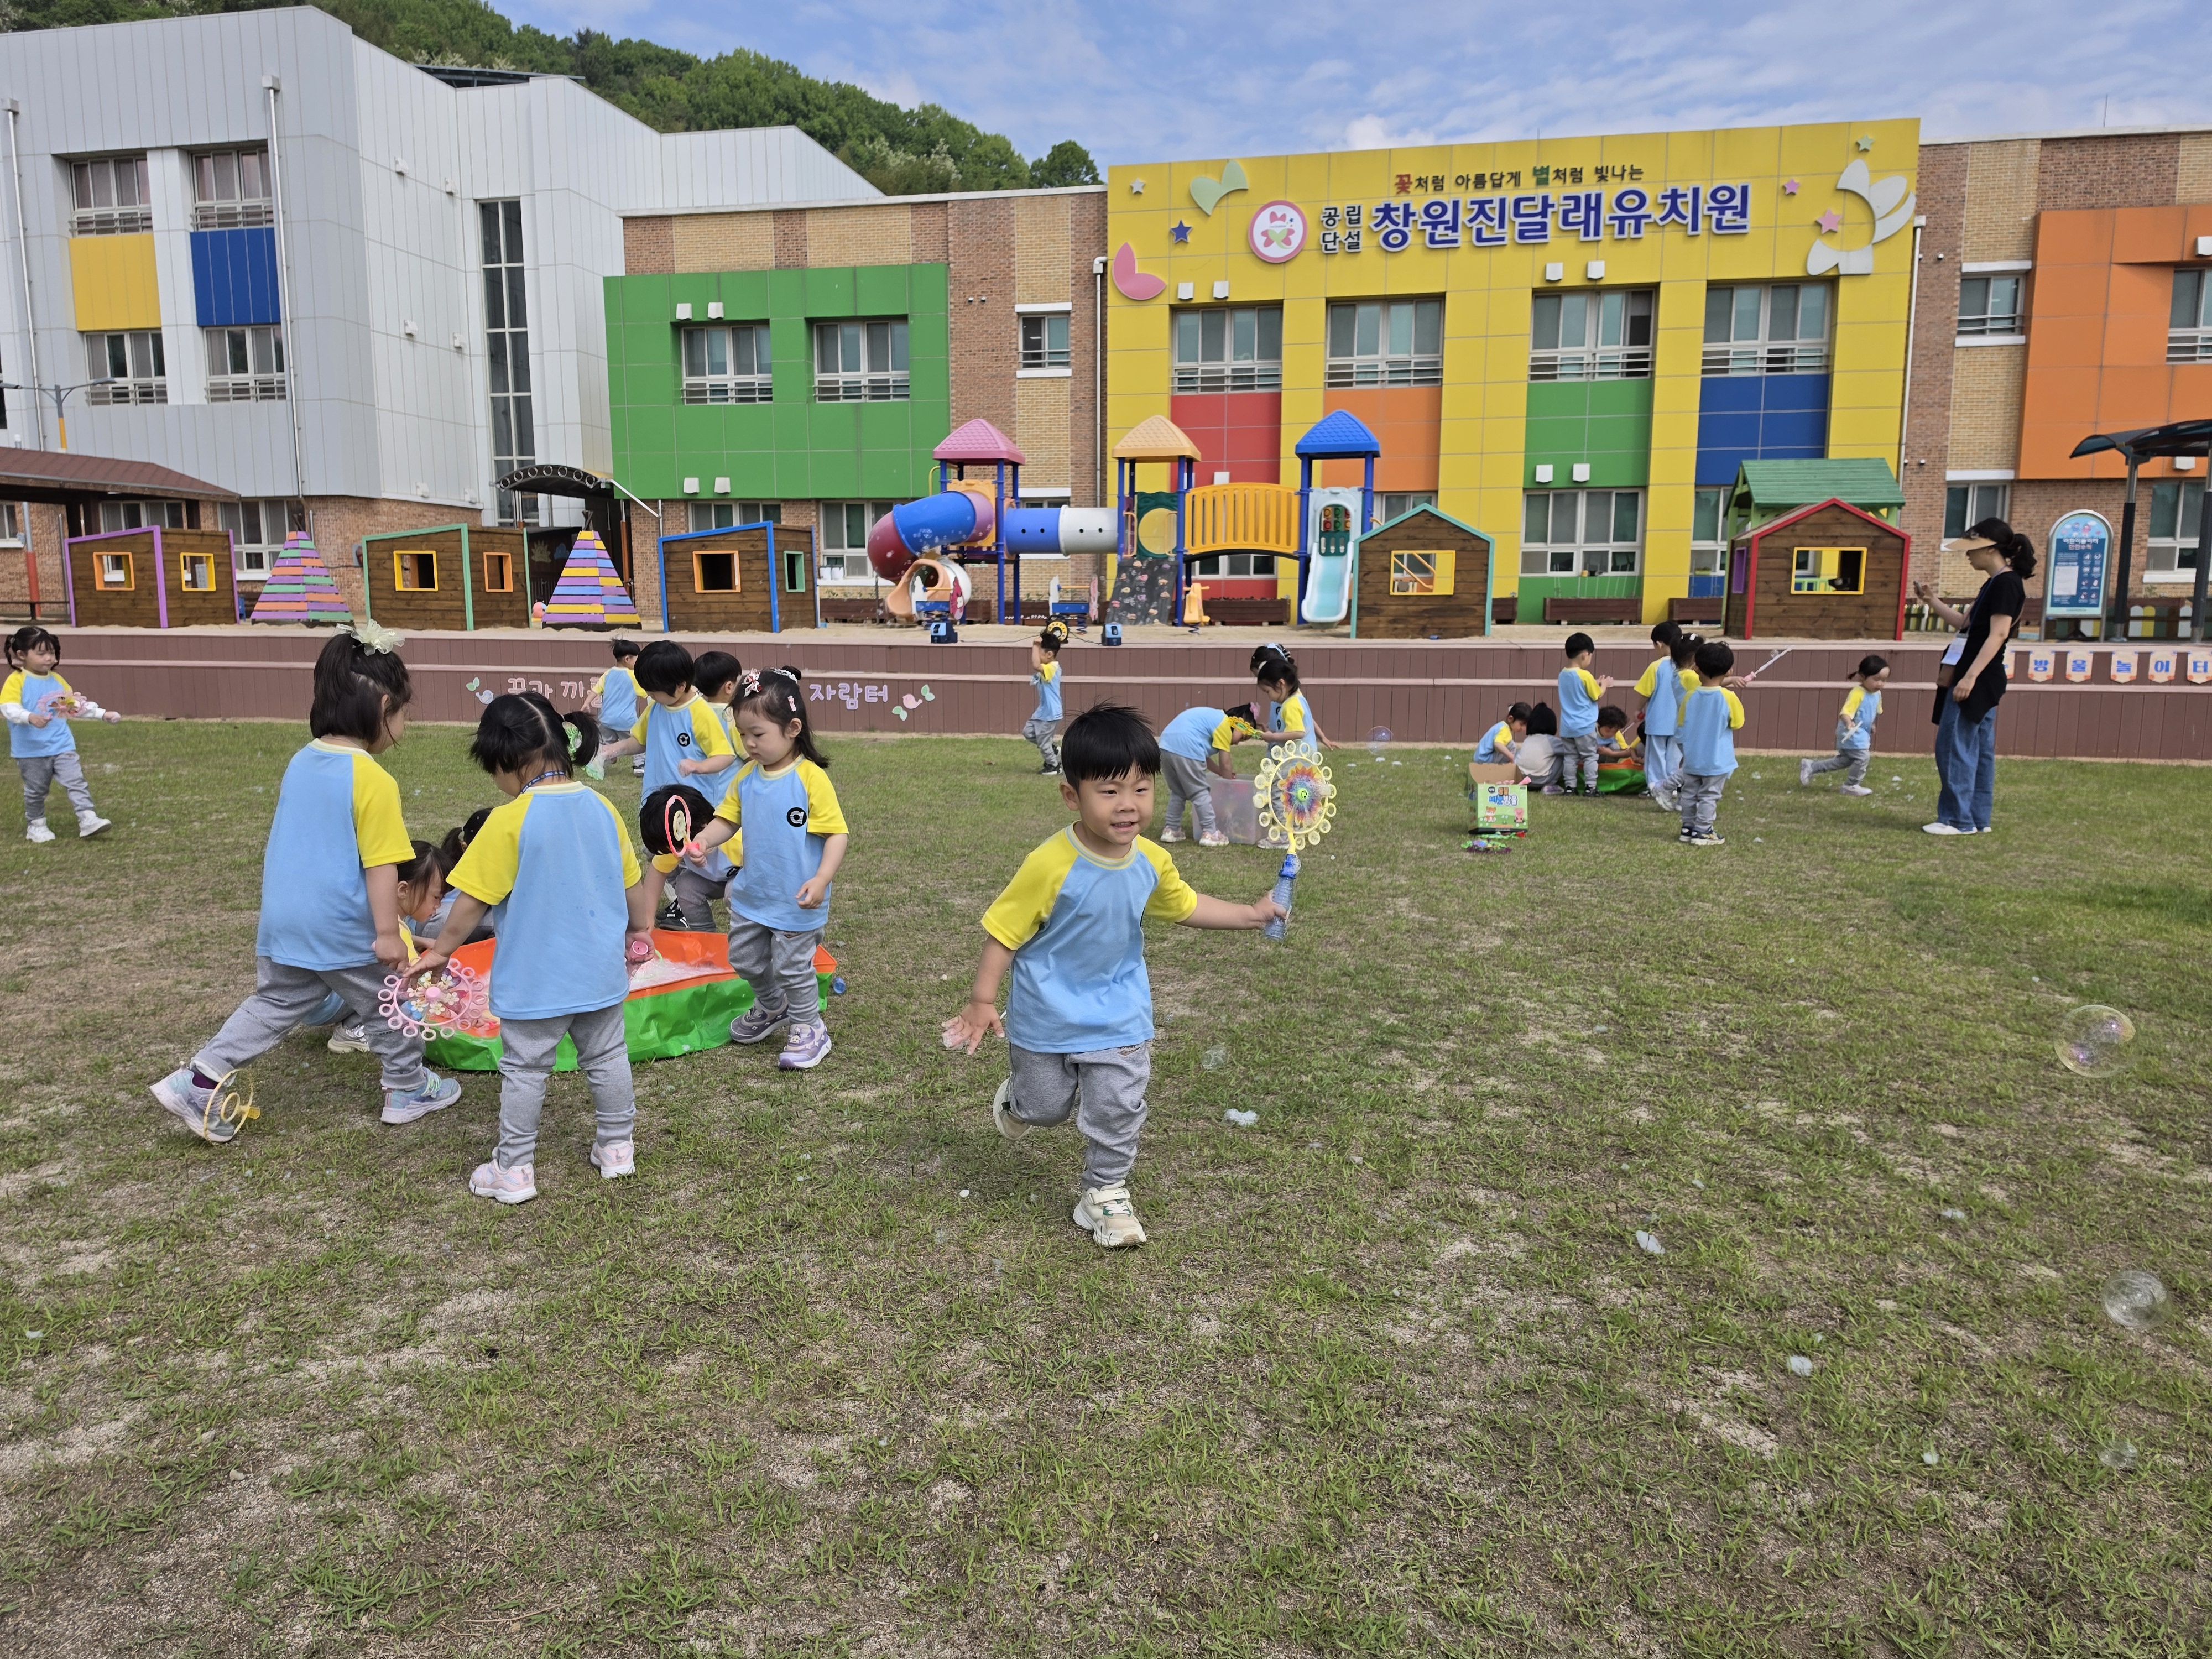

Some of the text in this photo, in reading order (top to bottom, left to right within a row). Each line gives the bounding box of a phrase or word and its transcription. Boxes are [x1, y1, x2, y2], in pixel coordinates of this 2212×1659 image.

[1394, 164, 1645, 194] 꽃처럼 아름답게 별처럼 빛나는
[1321, 205, 1361, 228] 공립
[1371, 184, 1751, 250] 창원진달래유치원
[1321, 231, 1361, 252] 단설
[808, 682, 888, 710] 자람터
